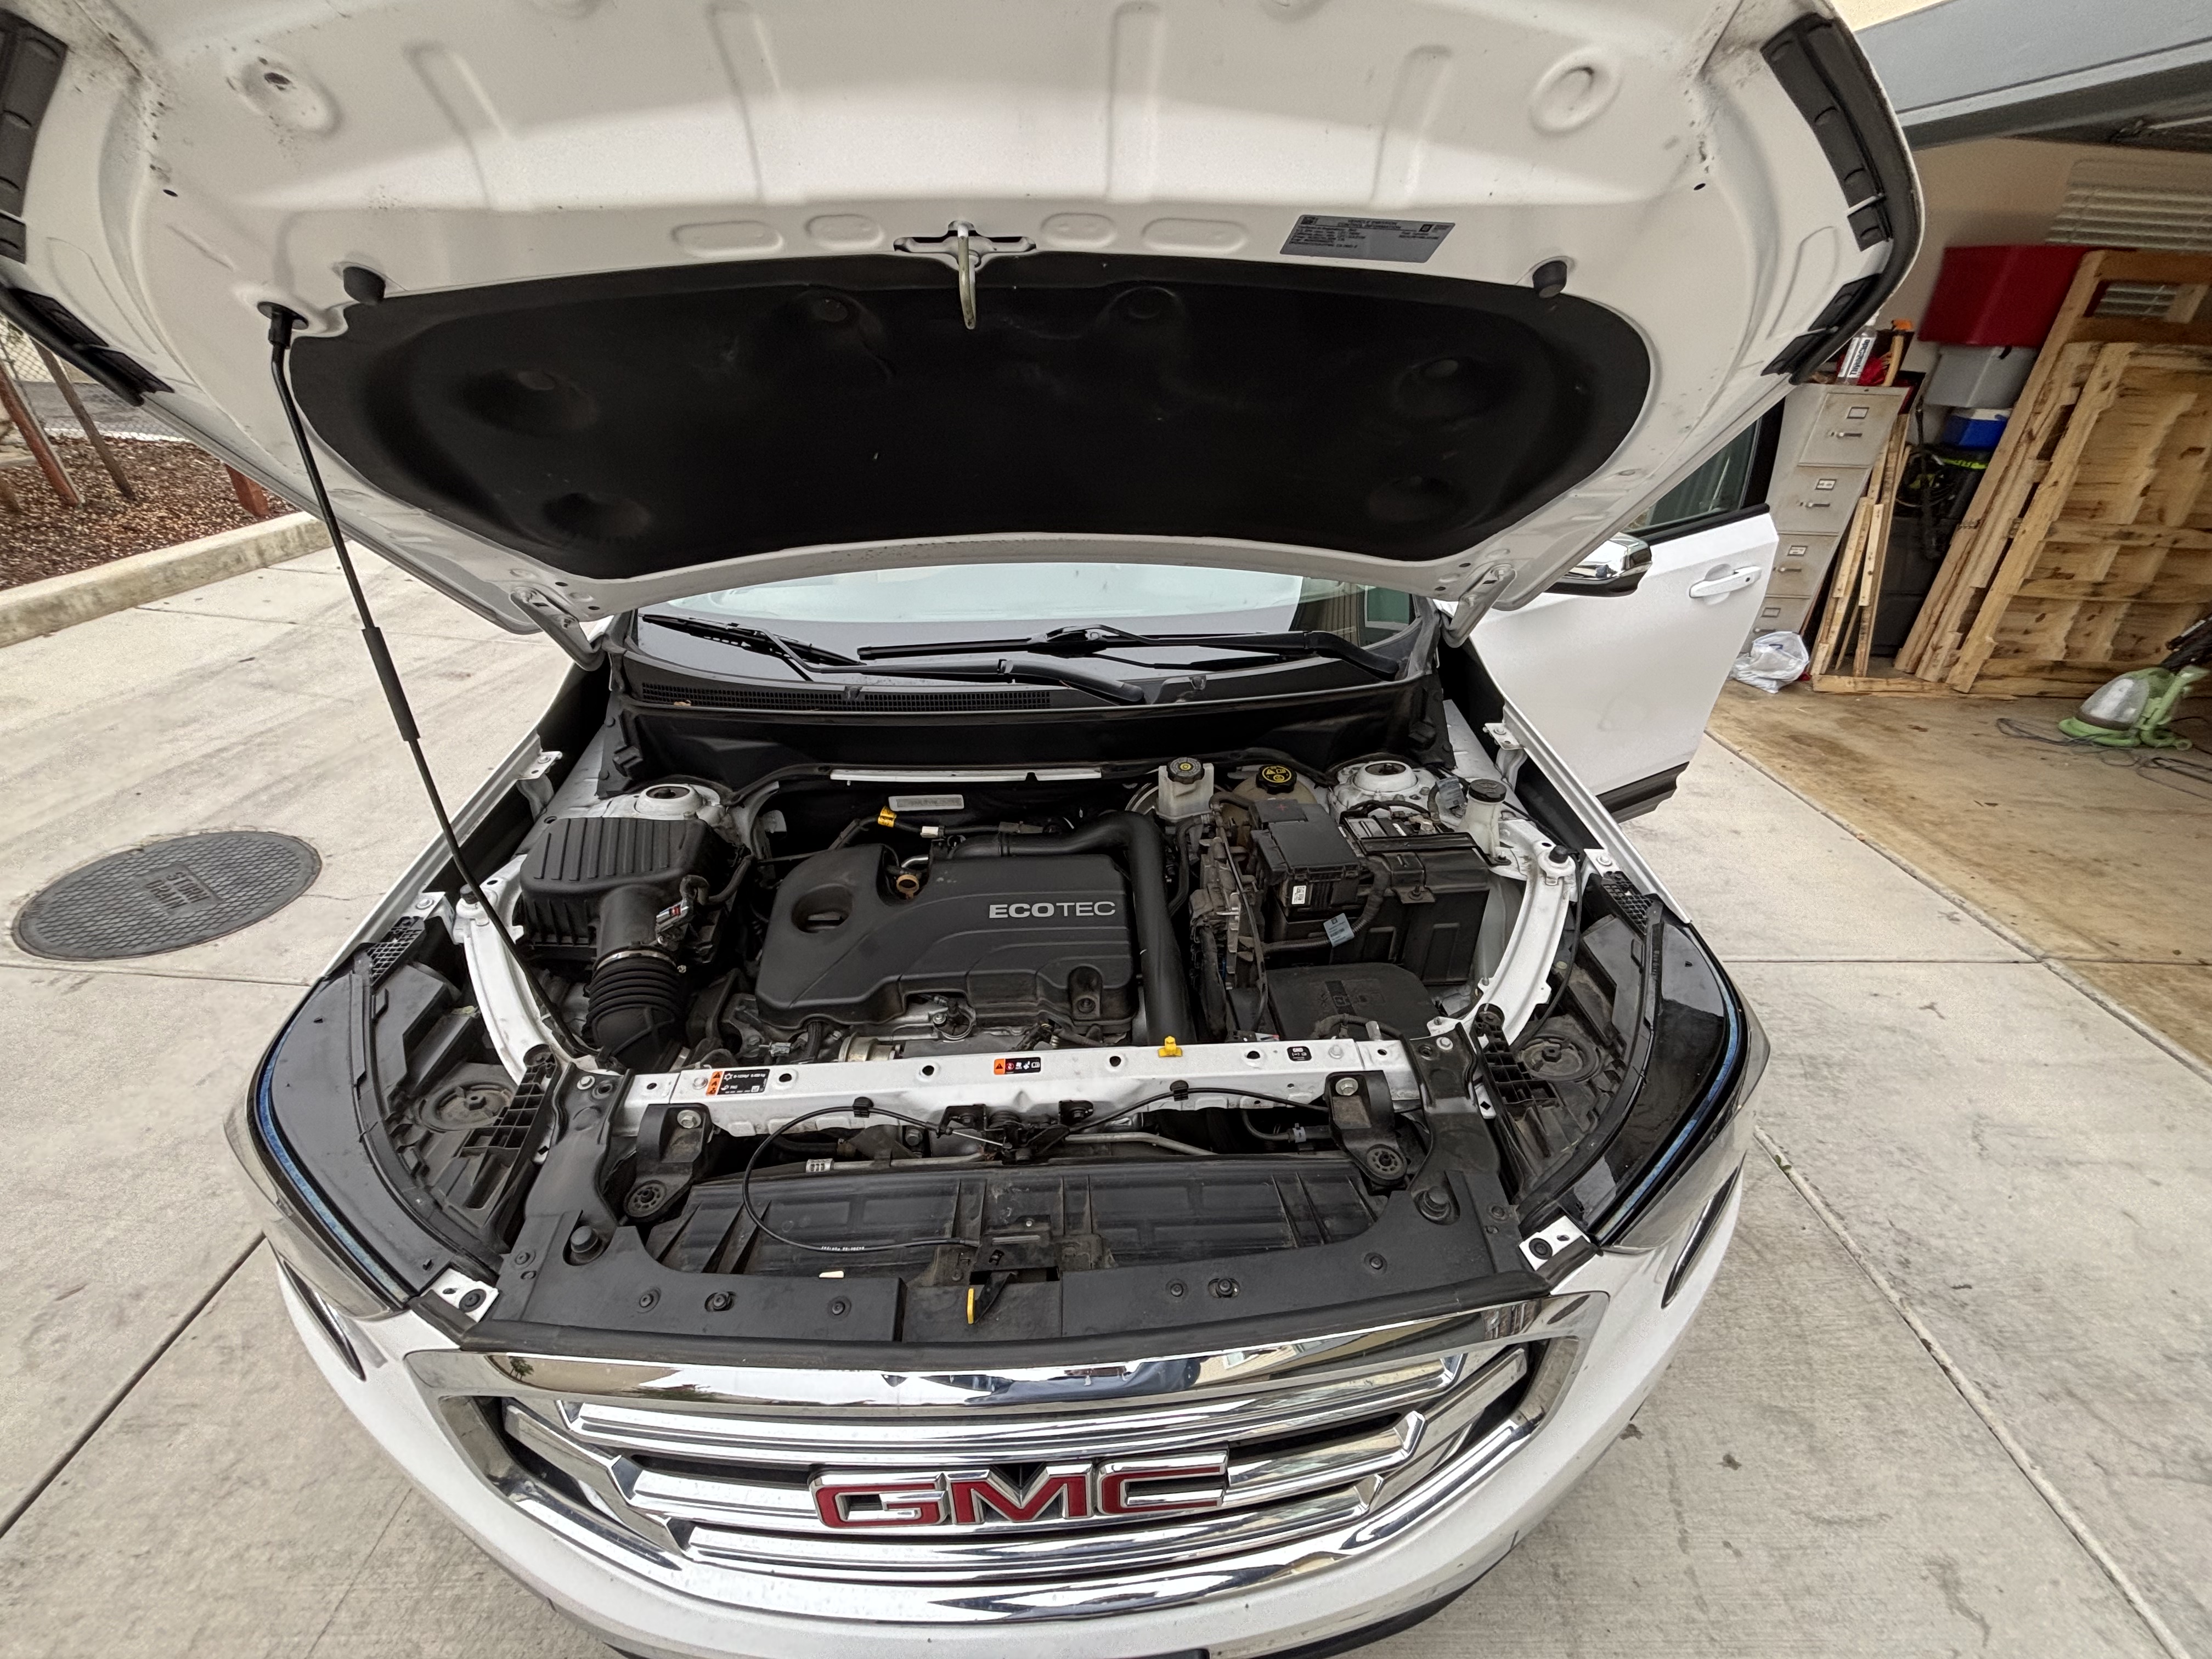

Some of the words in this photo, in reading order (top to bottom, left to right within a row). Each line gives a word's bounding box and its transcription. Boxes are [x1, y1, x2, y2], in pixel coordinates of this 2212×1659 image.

[144, 879, 189, 910] DRAIN
[166, 871, 210, 904] STORM
[989, 901, 1116, 918] ECOTEC
[809, 1449, 1229, 1528] GMC
